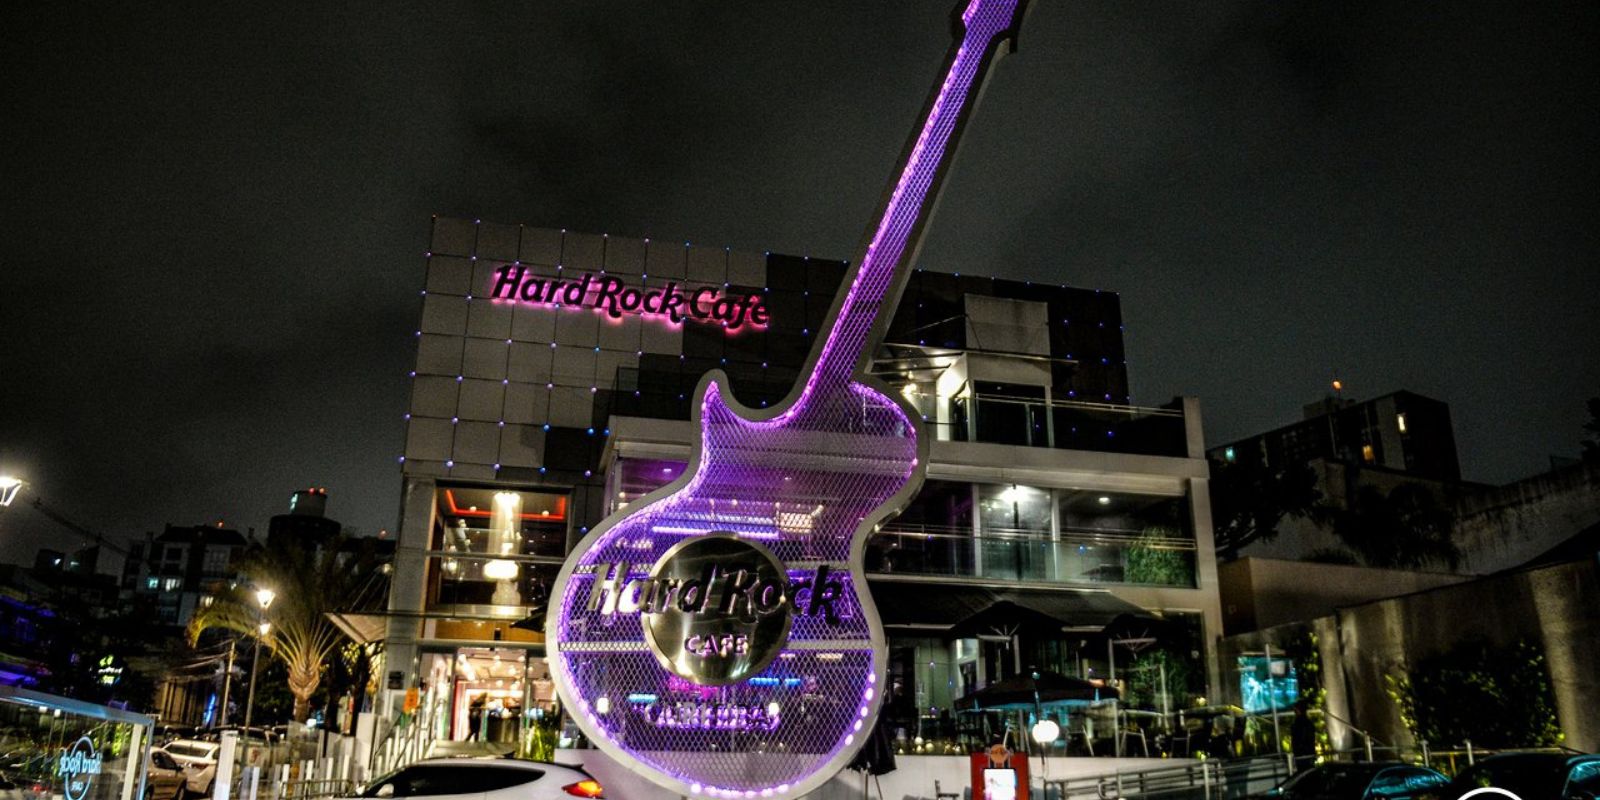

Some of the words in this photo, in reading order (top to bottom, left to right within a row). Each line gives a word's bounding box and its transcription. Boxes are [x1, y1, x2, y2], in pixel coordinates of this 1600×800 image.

[491, 265, 592, 305] Hard
[594, 275, 685, 324] Rock
[689, 286, 772, 329] Cafe
[586, 561, 716, 616] Hard
[719, 564, 843, 624] Rock
[684, 634, 749, 657] CAFE
